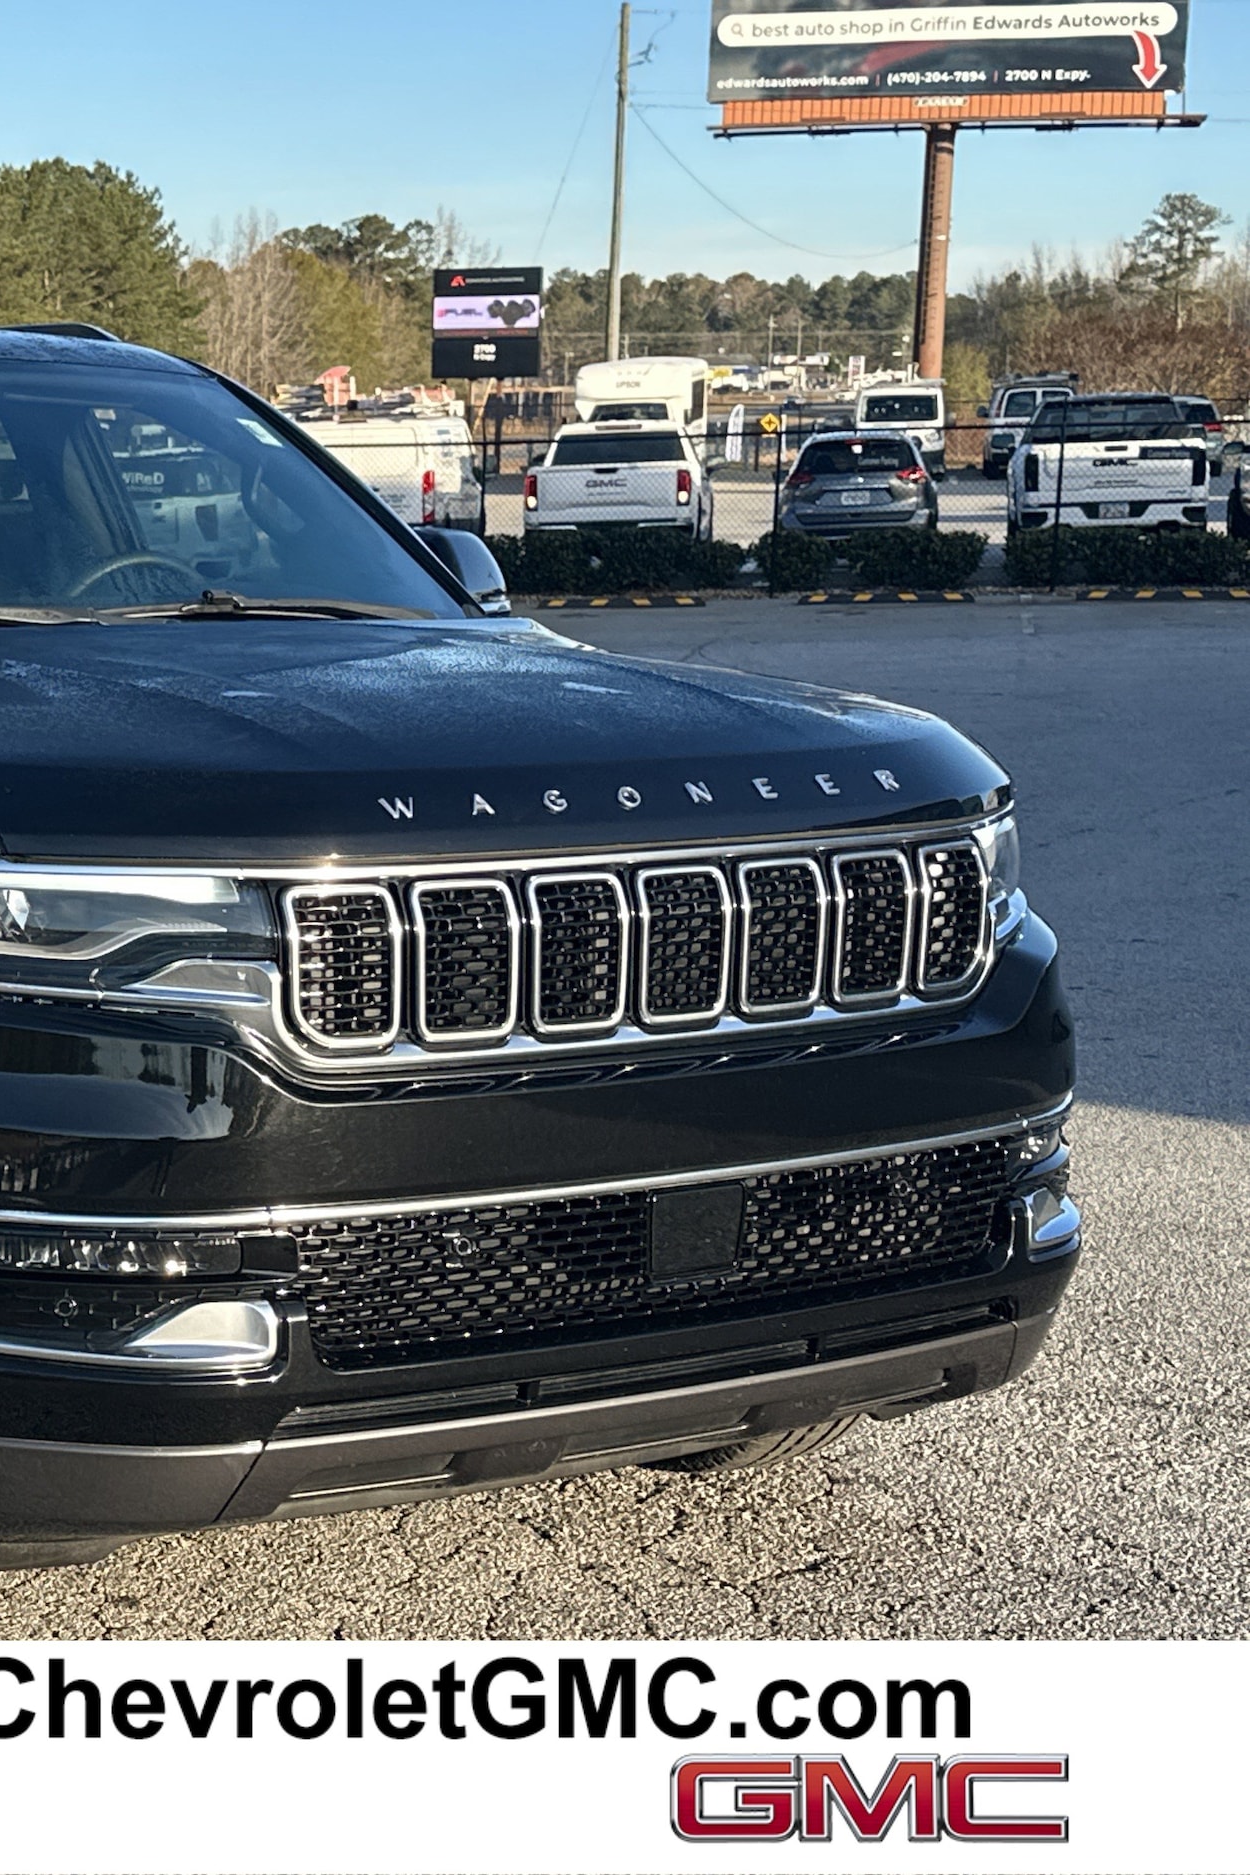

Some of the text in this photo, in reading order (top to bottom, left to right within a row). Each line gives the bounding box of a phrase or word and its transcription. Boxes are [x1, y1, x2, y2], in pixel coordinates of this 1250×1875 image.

[752, 12, 1160, 37] best auto shop in Griffin Edwards Autoworks
[716, 74, 869, 89] edwardsautoworks.com
[1005, 70, 1038, 81] 2700
[1041, 69, 1051, 81] N
[585, 478, 627, 489] GMC
[378, 768, 901, 820] WAGONEER
